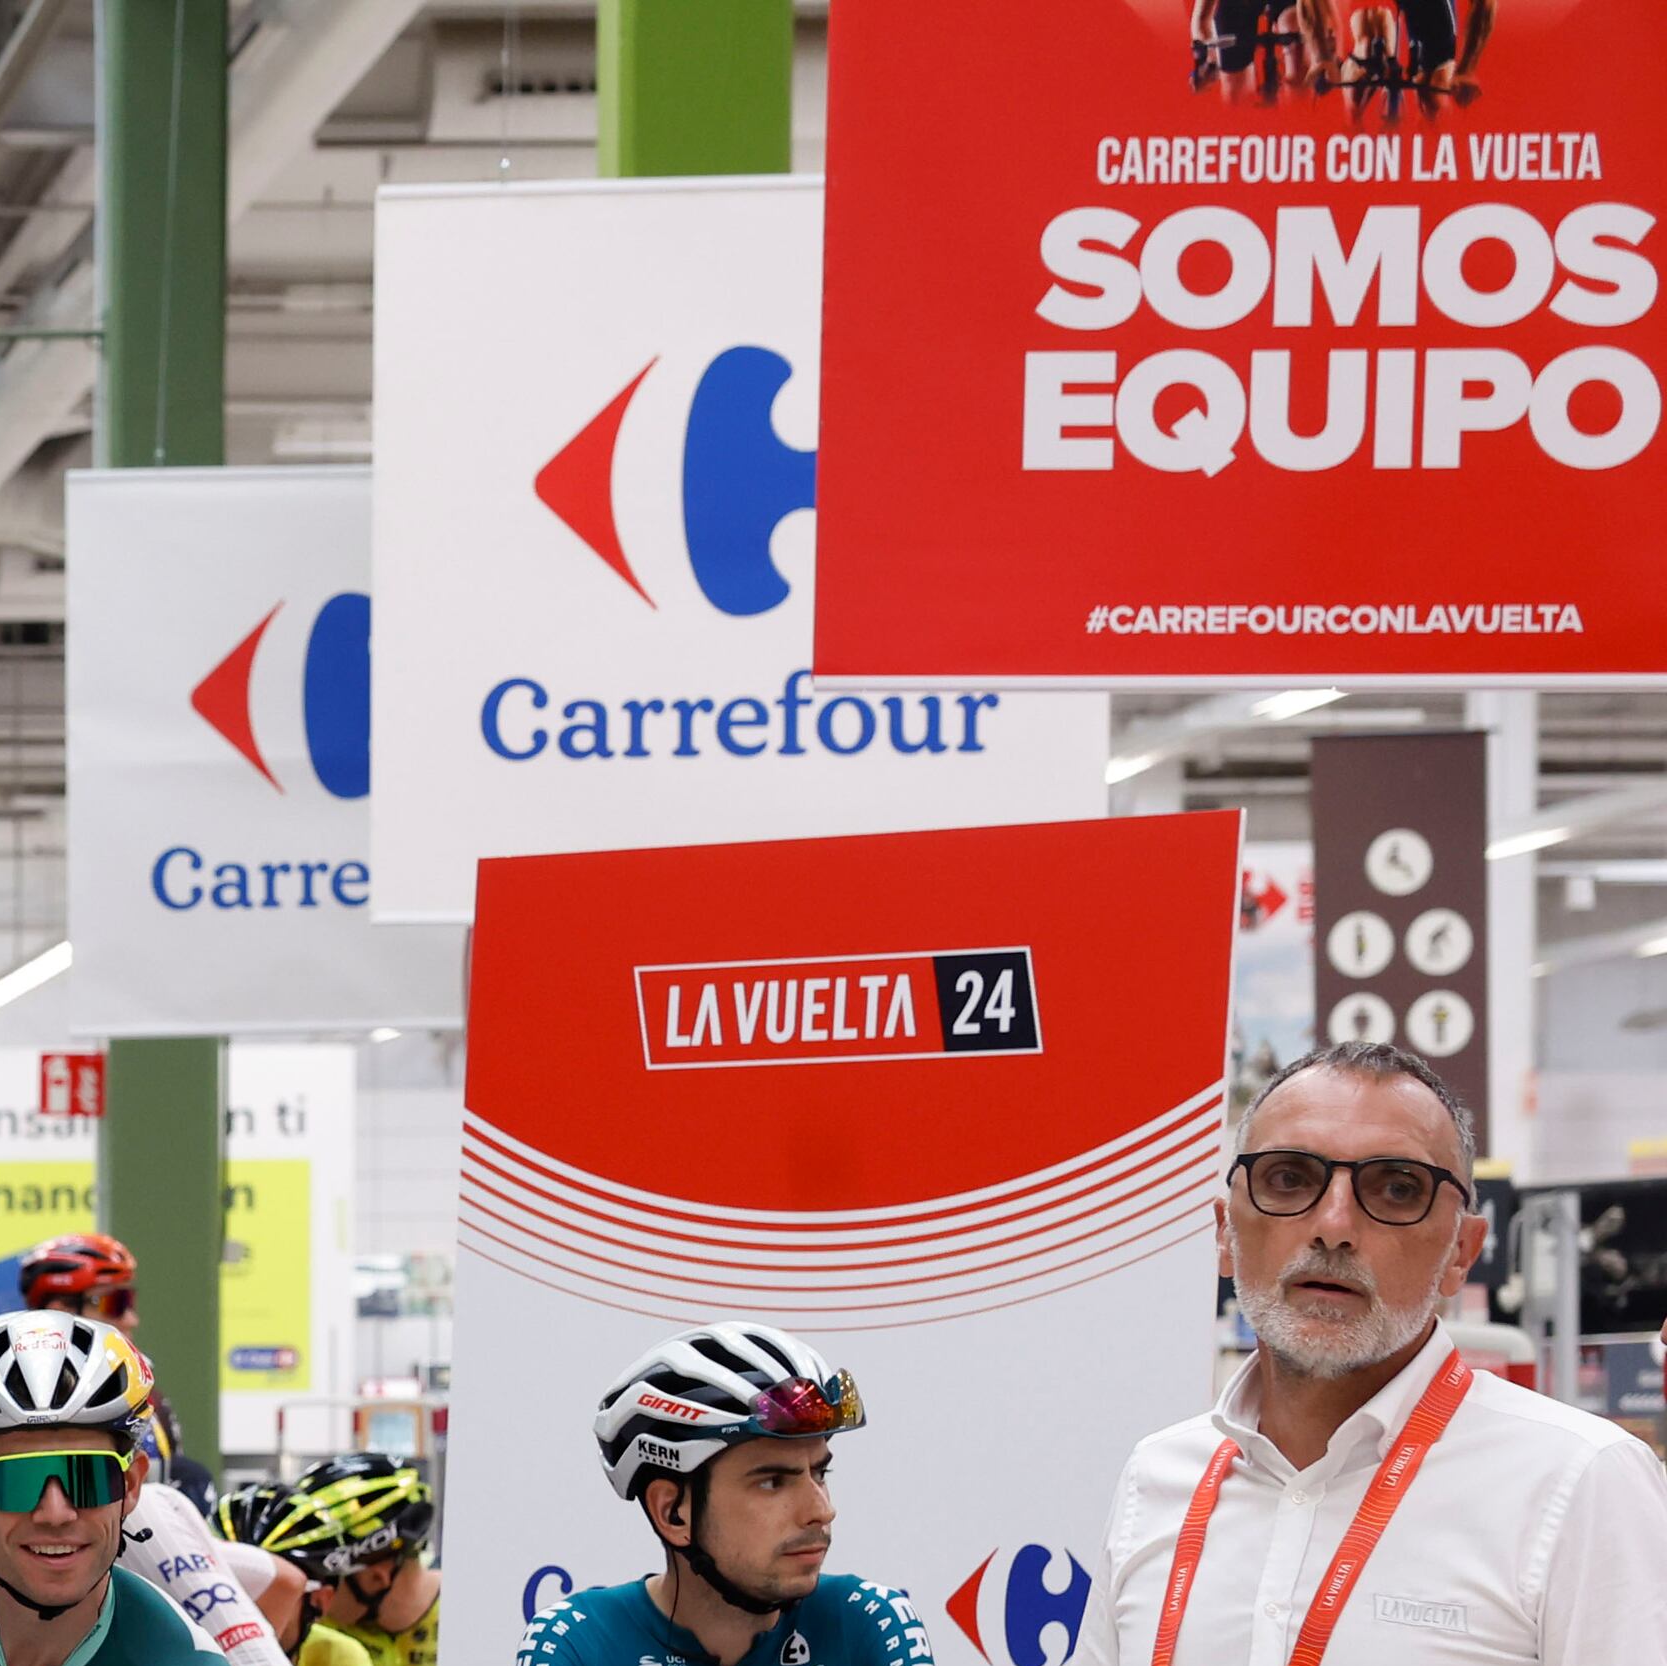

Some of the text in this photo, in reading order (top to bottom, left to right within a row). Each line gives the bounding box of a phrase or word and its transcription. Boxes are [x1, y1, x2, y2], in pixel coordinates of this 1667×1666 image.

[1096, 133, 1602, 185] CARREFOUR CON LA VUELTA
[1035, 203, 1660, 331] SOMOS
[1022, 346, 1662, 478] EQUIPO
[1086, 604, 1584, 635] #CARREFOURCONLAVUELTA
[480, 671, 998, 760] Carrefour
[667, 969, 1016, 1050] LA VUELTA 24
[637, 1393, 709, 1421] GIANT
[637, 1439, 680, 1462] KERN
[1392, 1446, 1416, 1475] VUELTA
[1329, 1563, 1353, 1595] VUELTA
